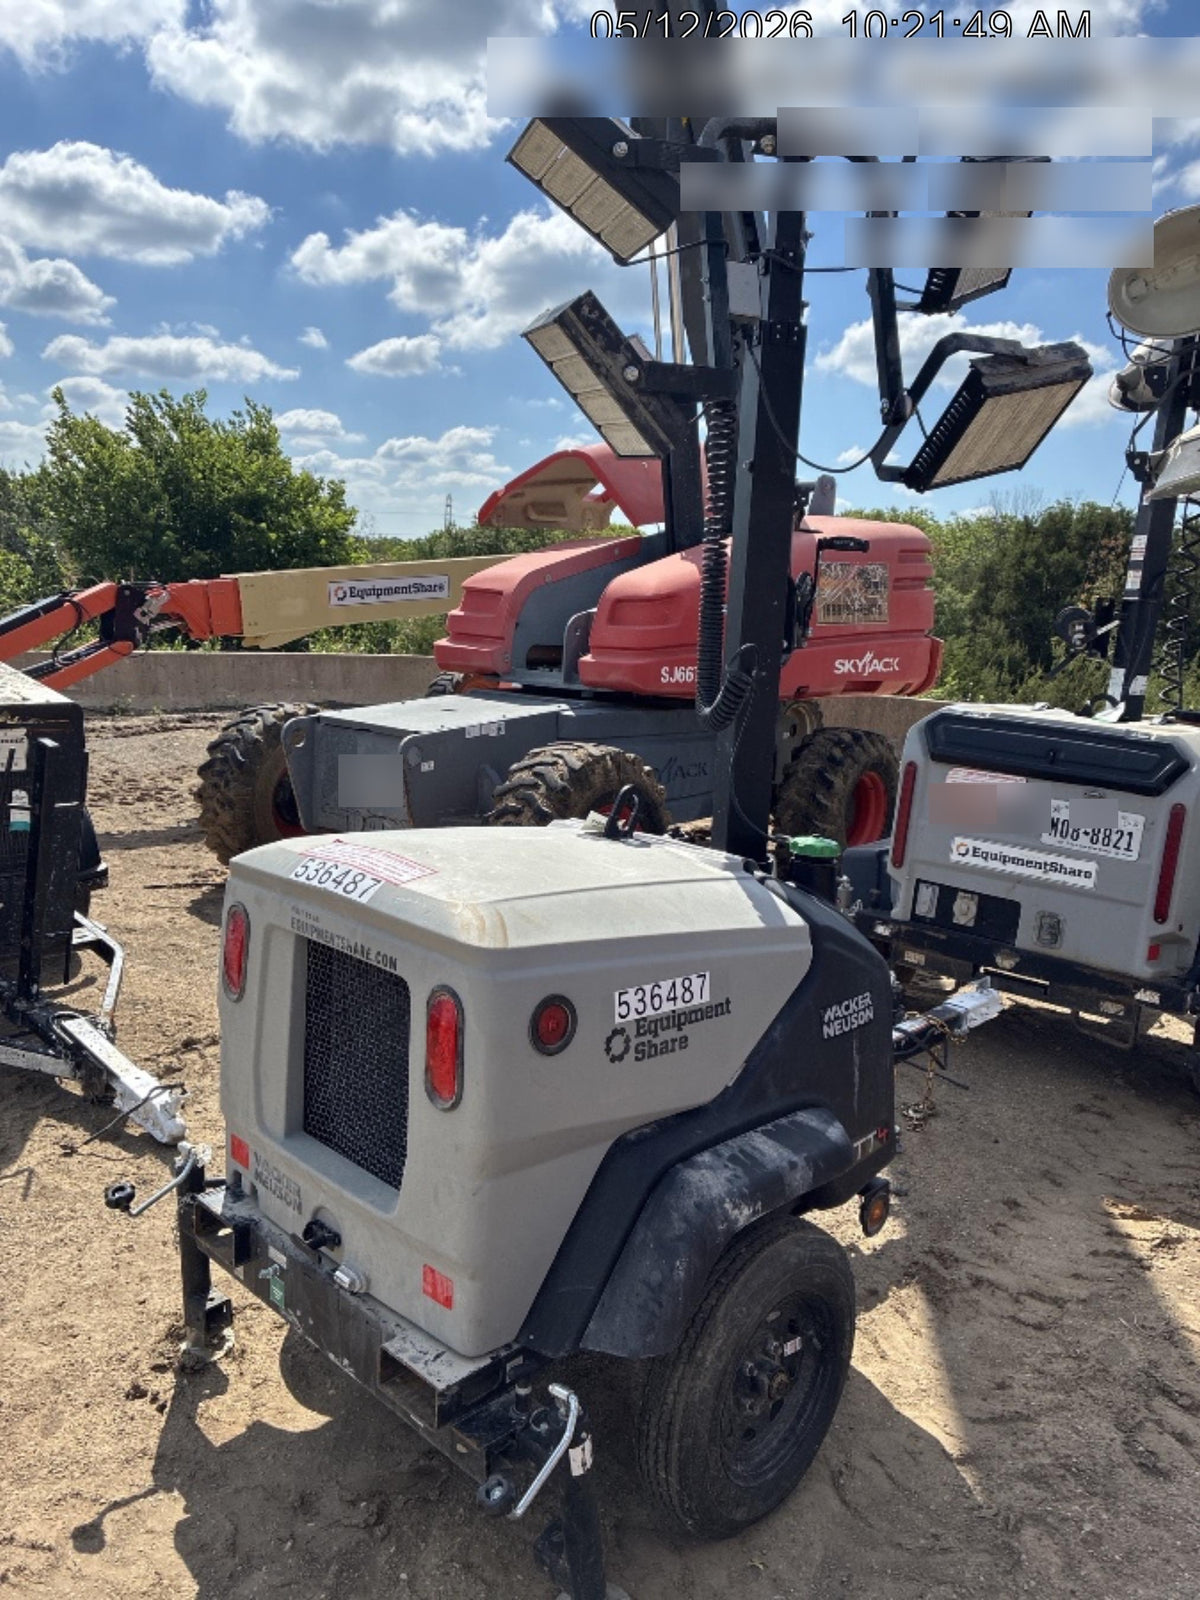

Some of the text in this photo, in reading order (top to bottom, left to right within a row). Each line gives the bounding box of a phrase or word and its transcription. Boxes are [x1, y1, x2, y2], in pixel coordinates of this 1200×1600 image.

[348, 582, 446, 599] EquipmentShare
[833, 651, 900, 676] SKYJACK
[294, 858, 381, 898] 536487
[971, 845, 1093, 881] EquipmentShare
[618, 974, 706, 1019] 536487
[634, 997, 732, 1039] Equipment
[822, 1010, 874, 1039] NEUSON
[634, 1034, 689, 1062] Share
